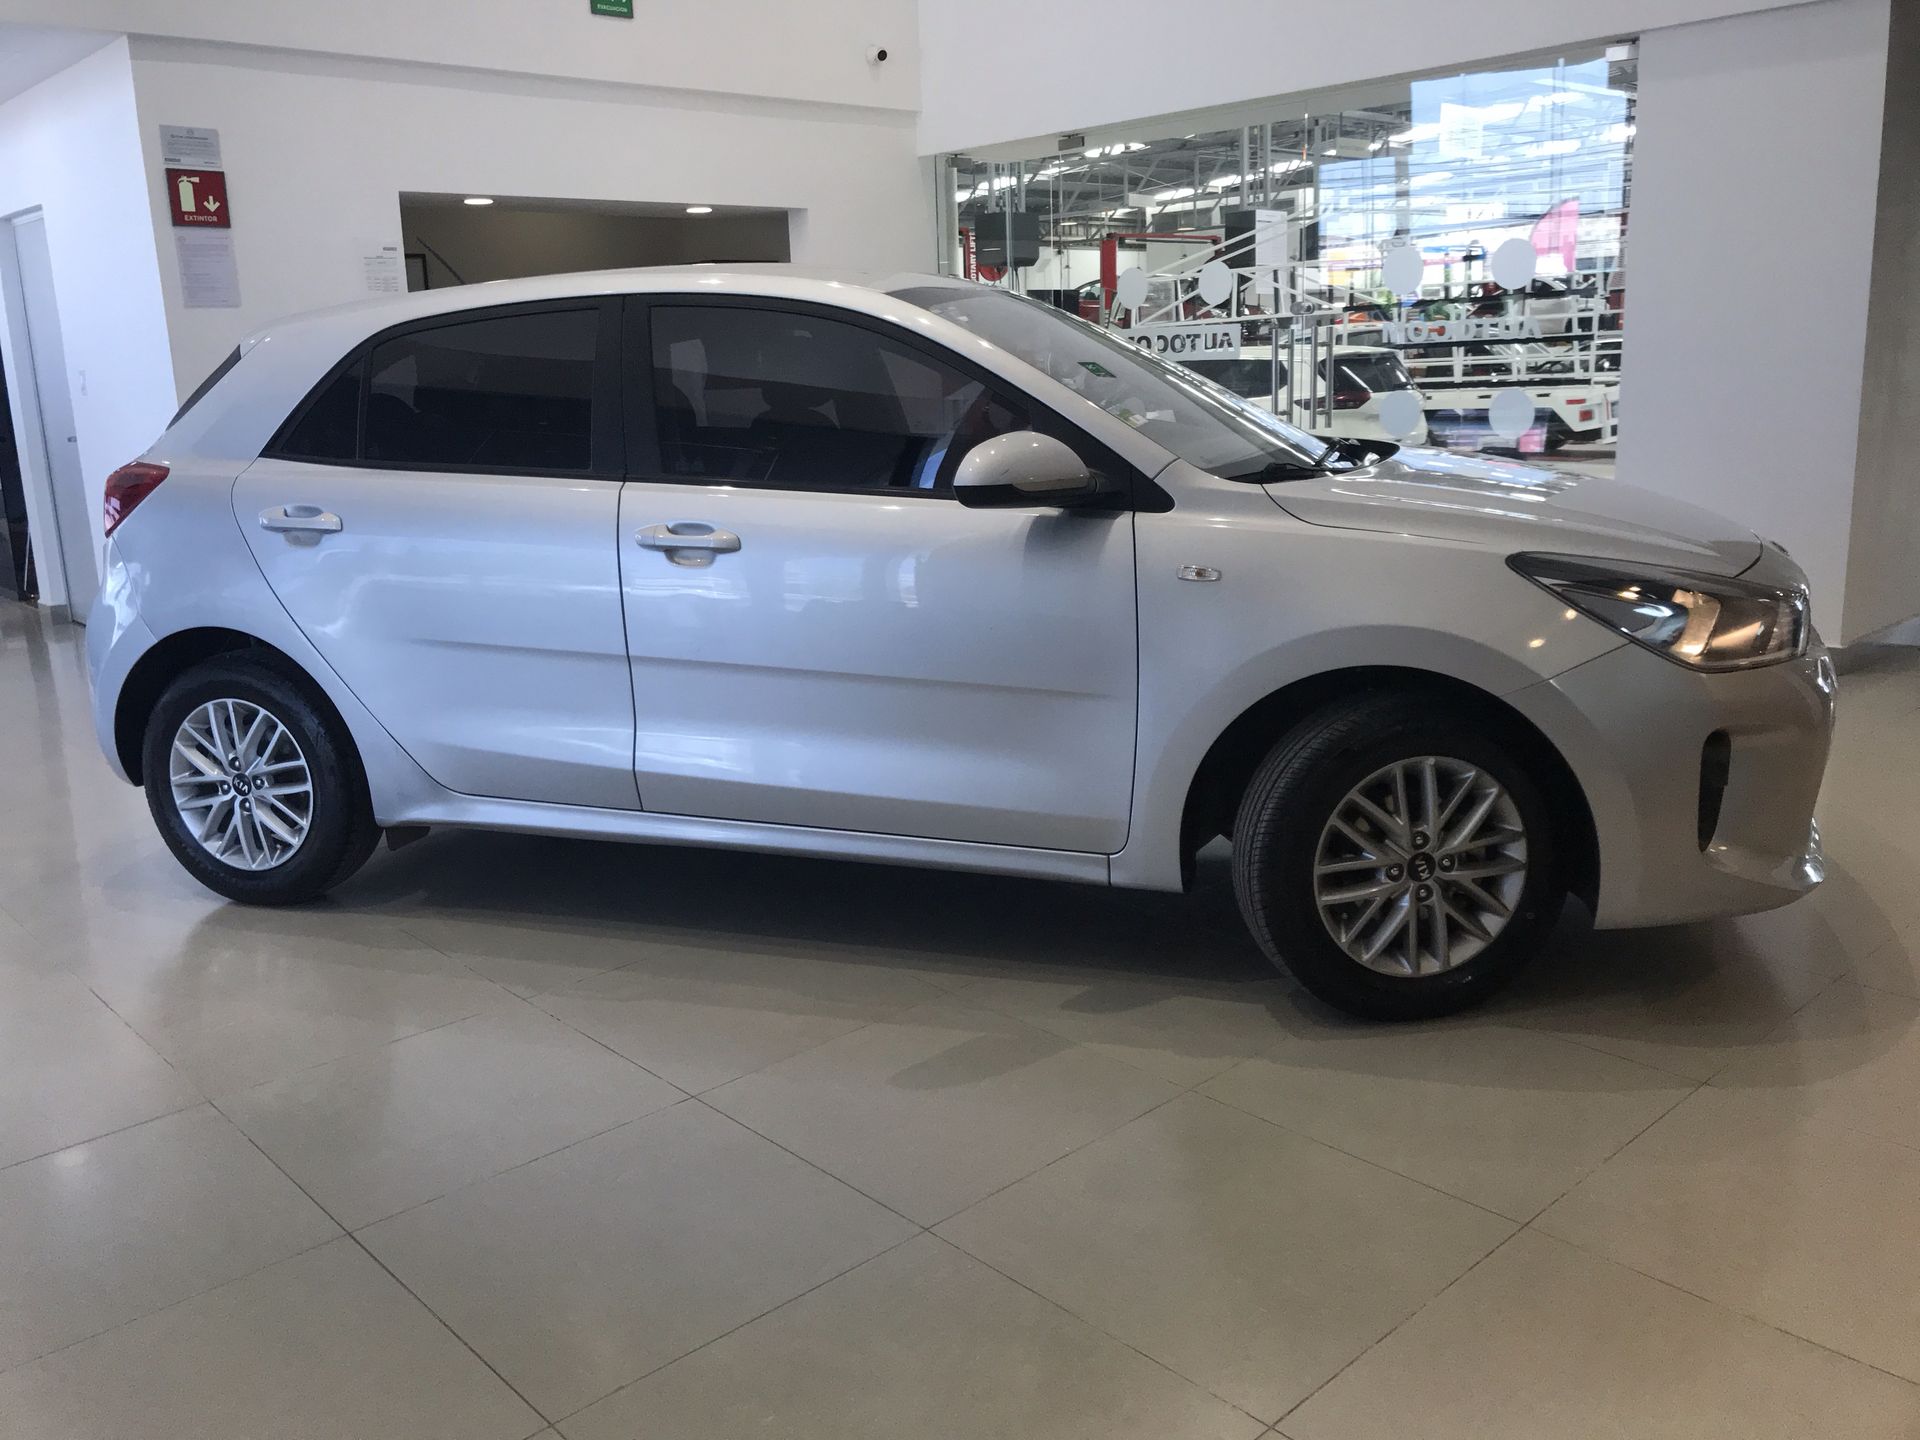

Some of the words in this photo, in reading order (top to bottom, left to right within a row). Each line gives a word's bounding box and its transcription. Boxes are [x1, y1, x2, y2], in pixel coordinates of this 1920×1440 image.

[184, 214, 218, 223] EXTINTOR
[969, 254, 977, 281] OTARY
[233, 776, 249, 794] KIA
[1414, 856, 1431, 880] KIA
